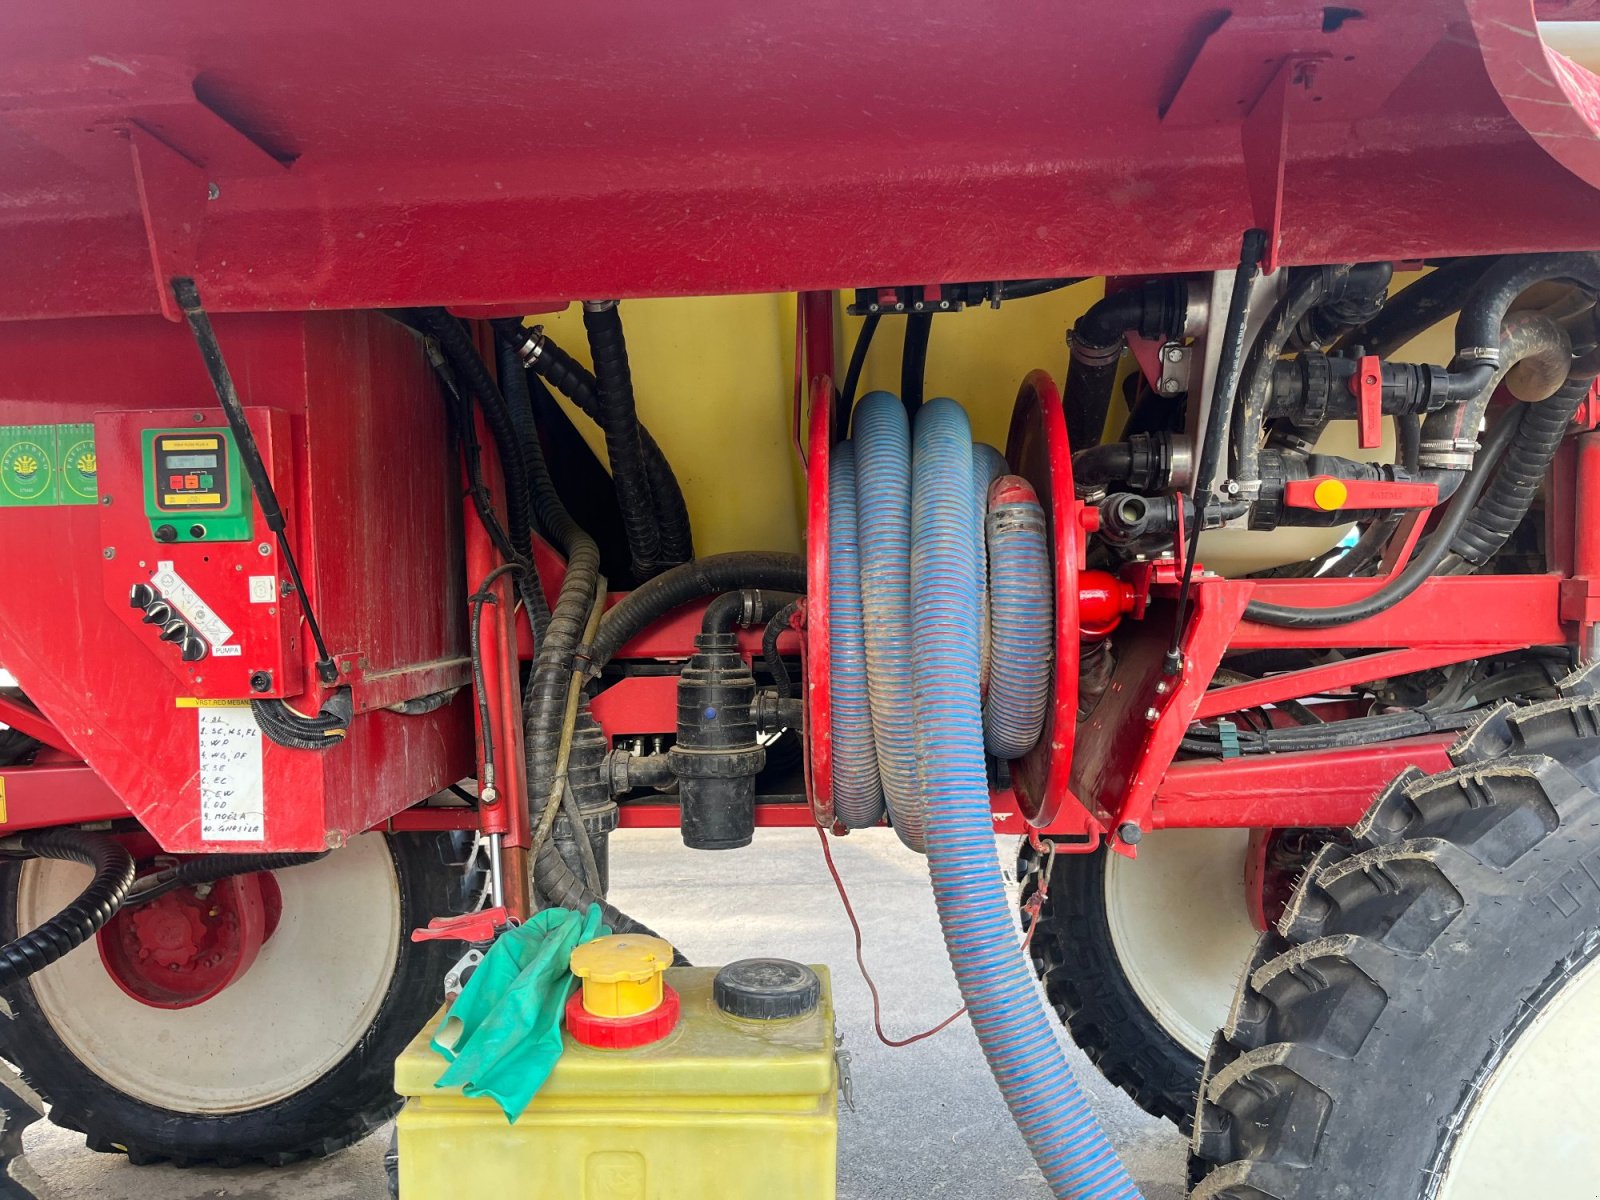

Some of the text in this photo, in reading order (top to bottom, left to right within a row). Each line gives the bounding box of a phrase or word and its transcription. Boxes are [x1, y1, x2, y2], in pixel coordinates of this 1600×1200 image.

[215, 647, 239, 655] PUMPA
[245, 728, 256, 736] FL
[210, 738, 229, 747] WP
[201, 750, 207, 759] 4.
[201, 763, 226, 772] 5. SE
[201, 776, 227, 785] 6. EC
[215, 790, 235, 798] EW
[213, 801, 227, 809] OD
[204, 812, 211, 821] 9.
